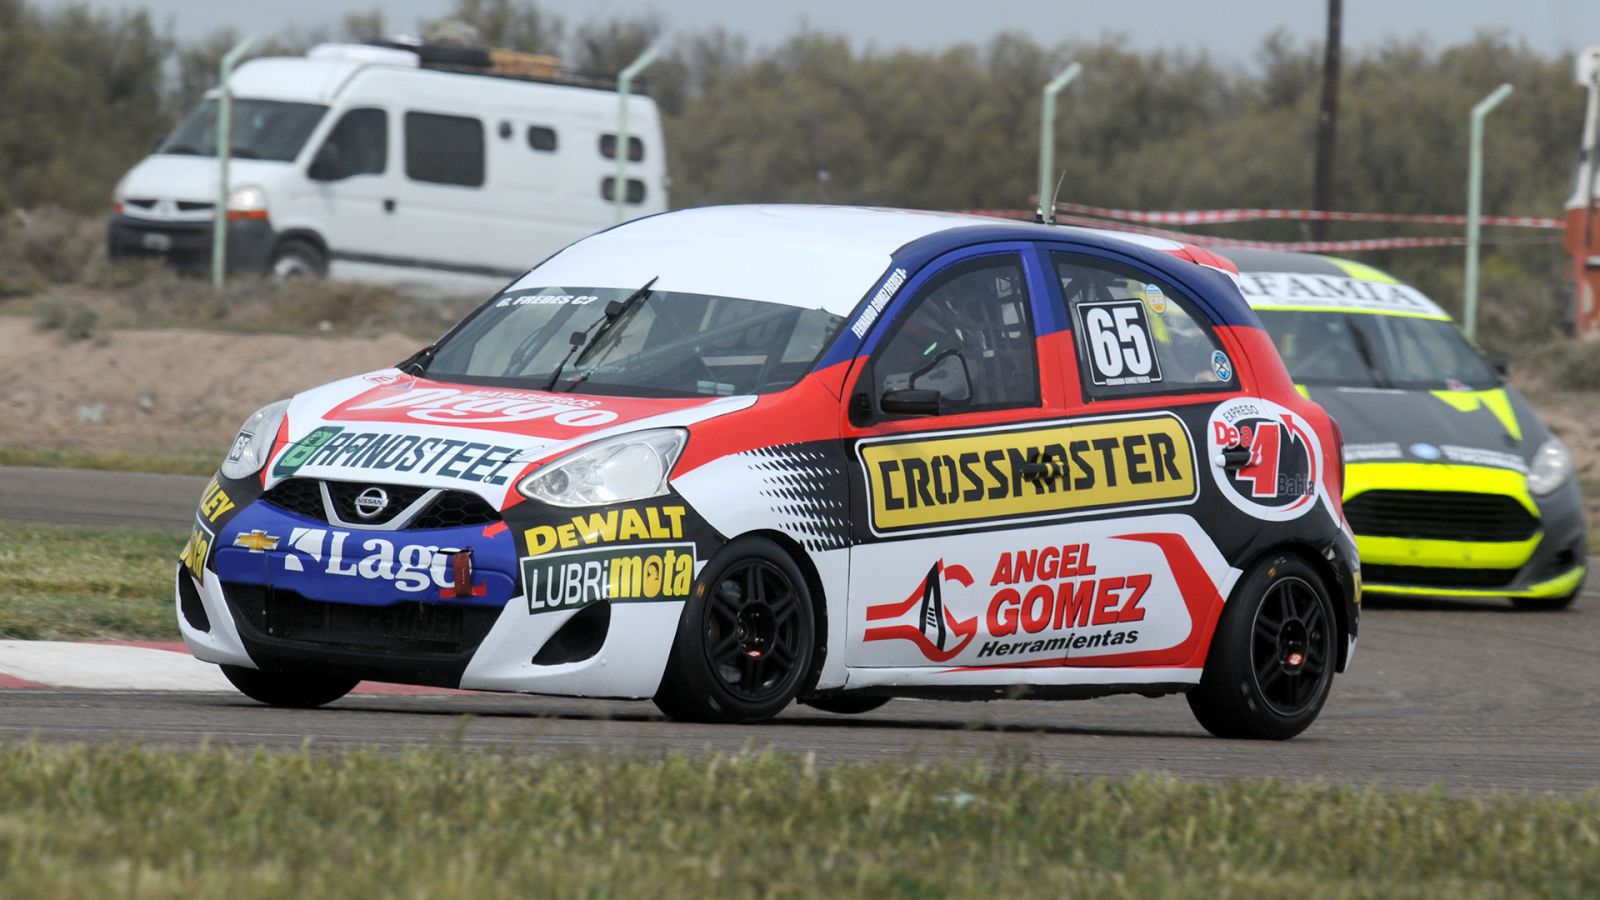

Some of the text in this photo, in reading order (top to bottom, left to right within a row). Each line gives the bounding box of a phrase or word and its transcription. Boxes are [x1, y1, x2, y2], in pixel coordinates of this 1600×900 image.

[870, 287, 891, 313] GOMEZ
[1086, 306, 1153, 377] 65
[345, 388, 619, 426] Drago
[1222, 404, 1259, 423] EXPRESO
[878, 432, 1182, 511] CROSSMASTER
[1213, 421, 1239, 448] De
[1235, 422, 1280, 498] 4
[357, 497, 383, 506] NISSAN
[990, 543, 1096, 586] ANGEL
[986, 574, 1152, 638] GOMEZ
[977, 630, 1139, 658] Herramientas
